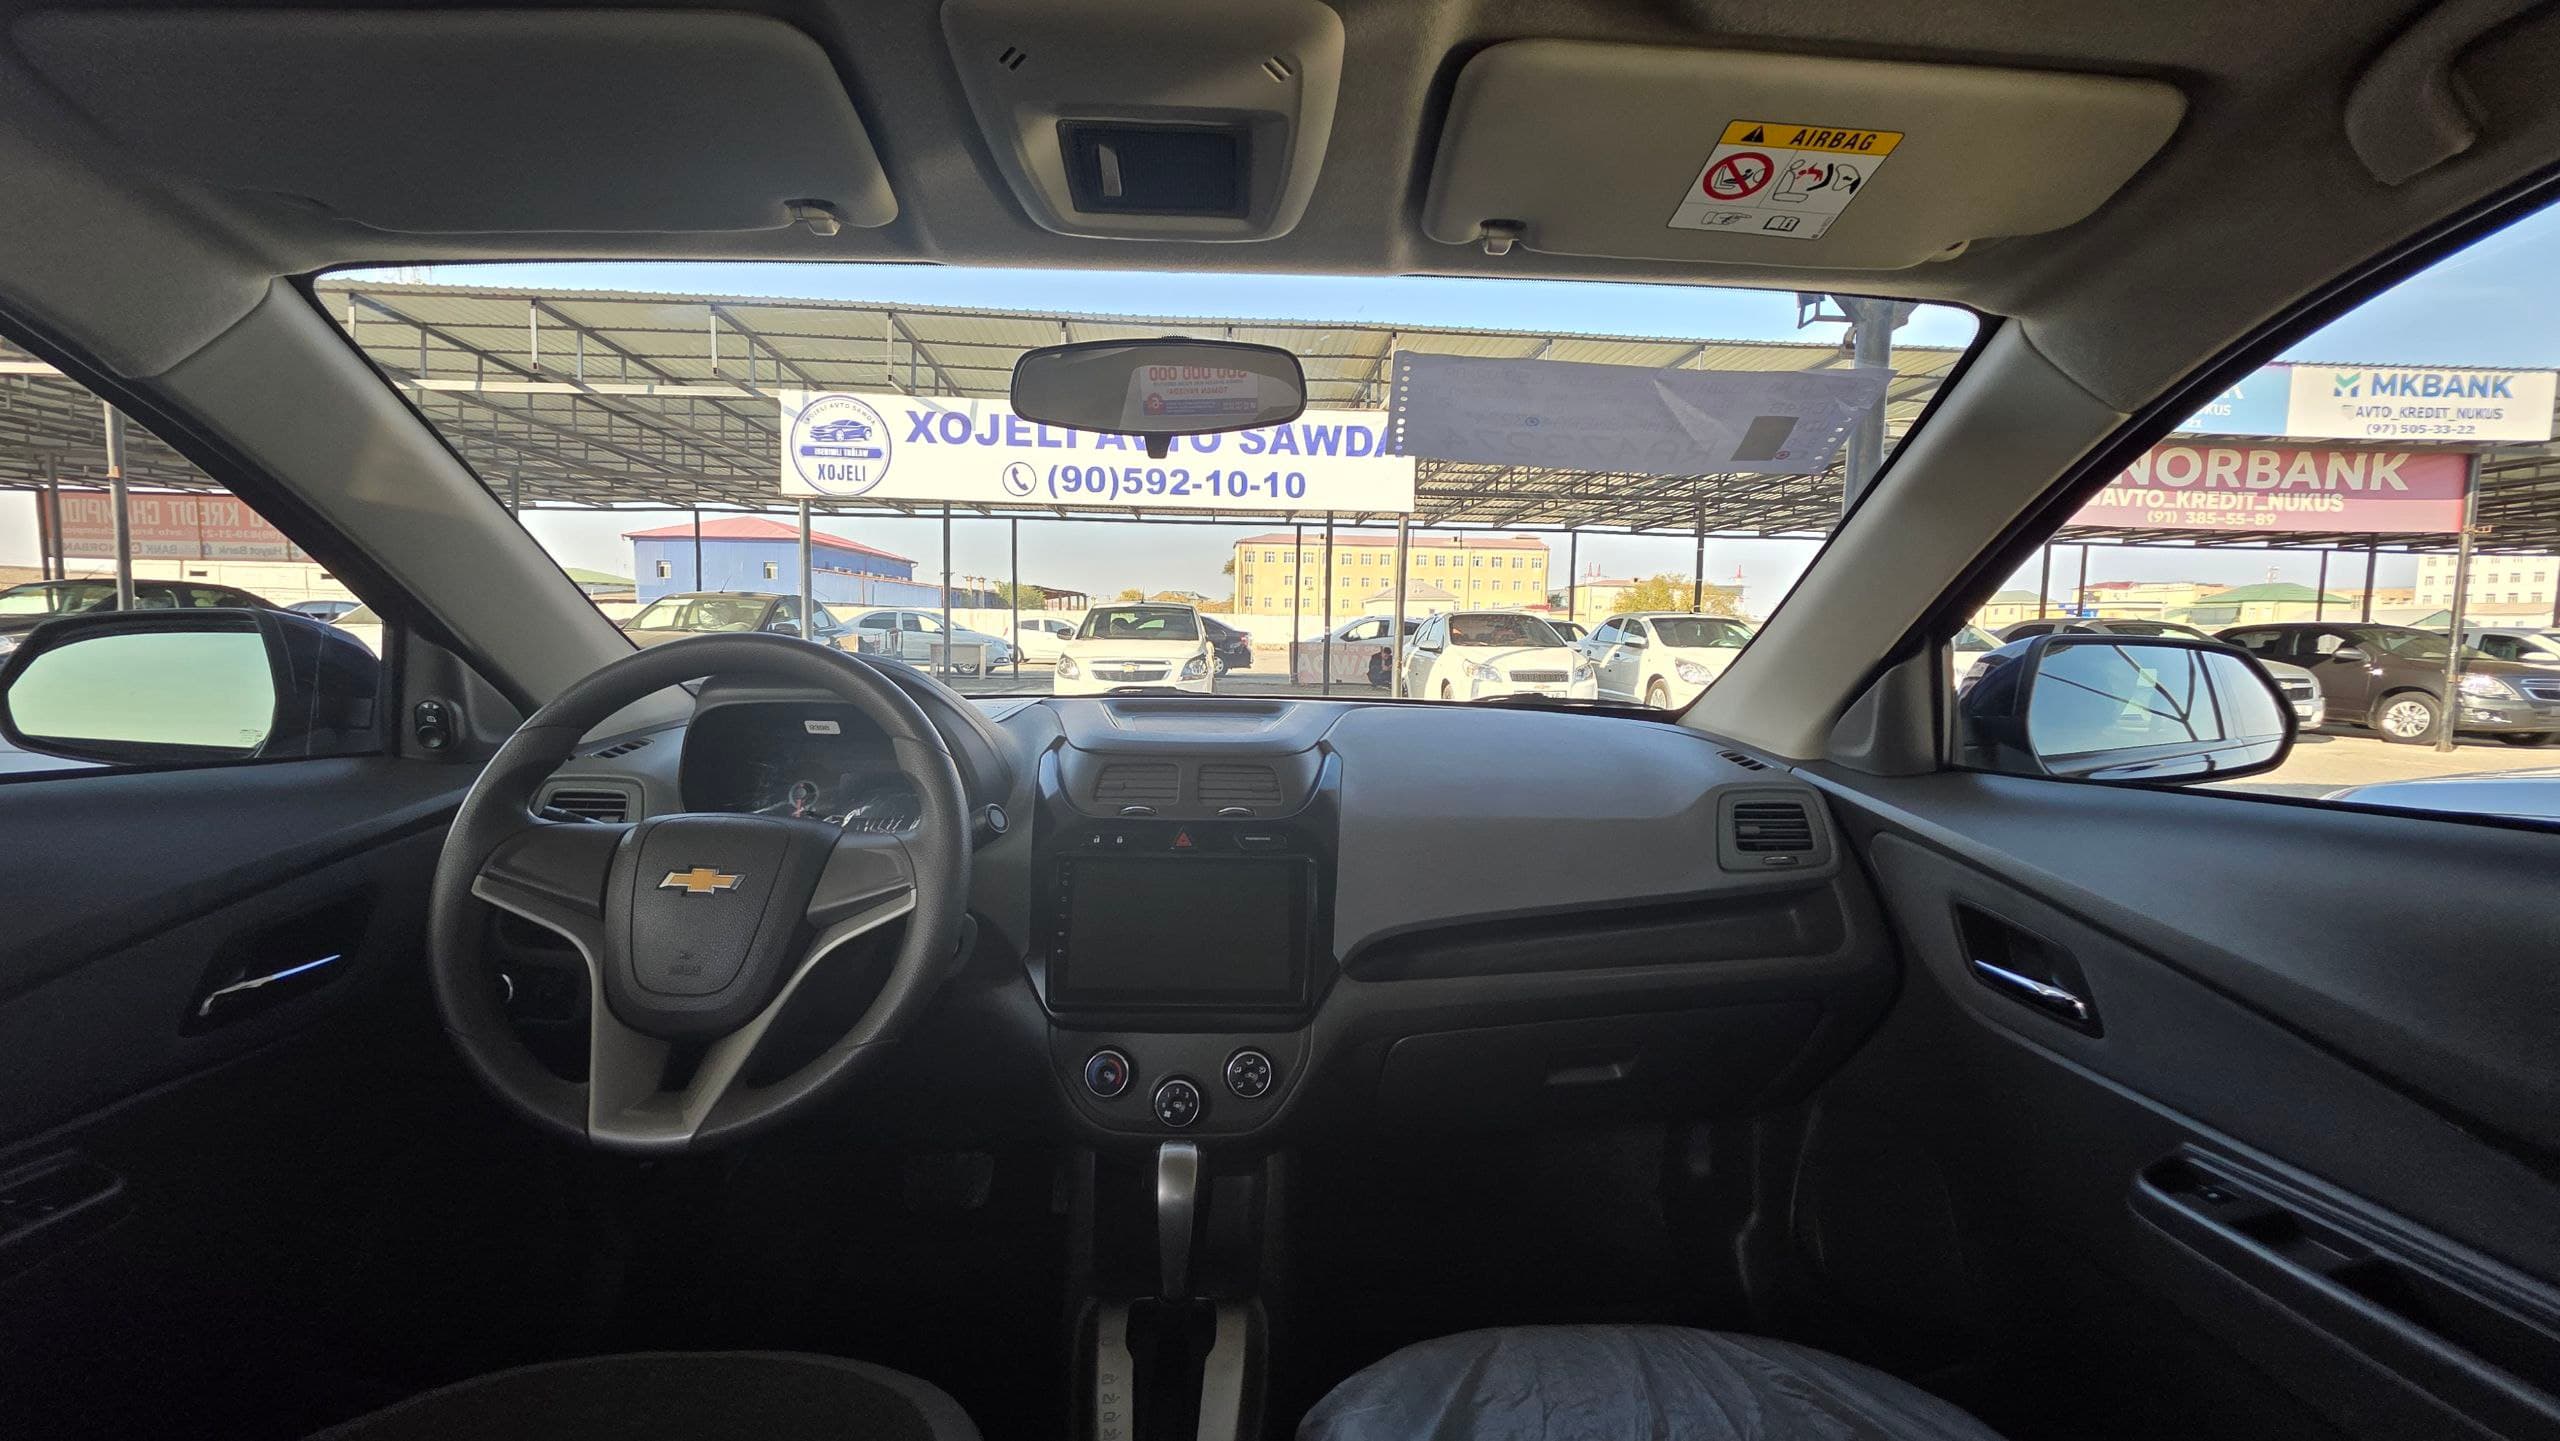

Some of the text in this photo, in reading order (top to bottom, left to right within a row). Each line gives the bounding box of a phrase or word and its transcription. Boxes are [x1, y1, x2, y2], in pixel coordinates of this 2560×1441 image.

[1789, 129, 1876, 151] AIRBAG
[2371, 373, 2515, 398] MKBANK
[905, 410, 1077, 448] XOJELI
[2366, 424, 2475, 435] (97) 505-33-22
[818, 464, 866, 481] XOJELI
[1048, 464, 1306, 499] (90)592-10-10
[2147, 511, 2277, 525] (91) 385-55-89
